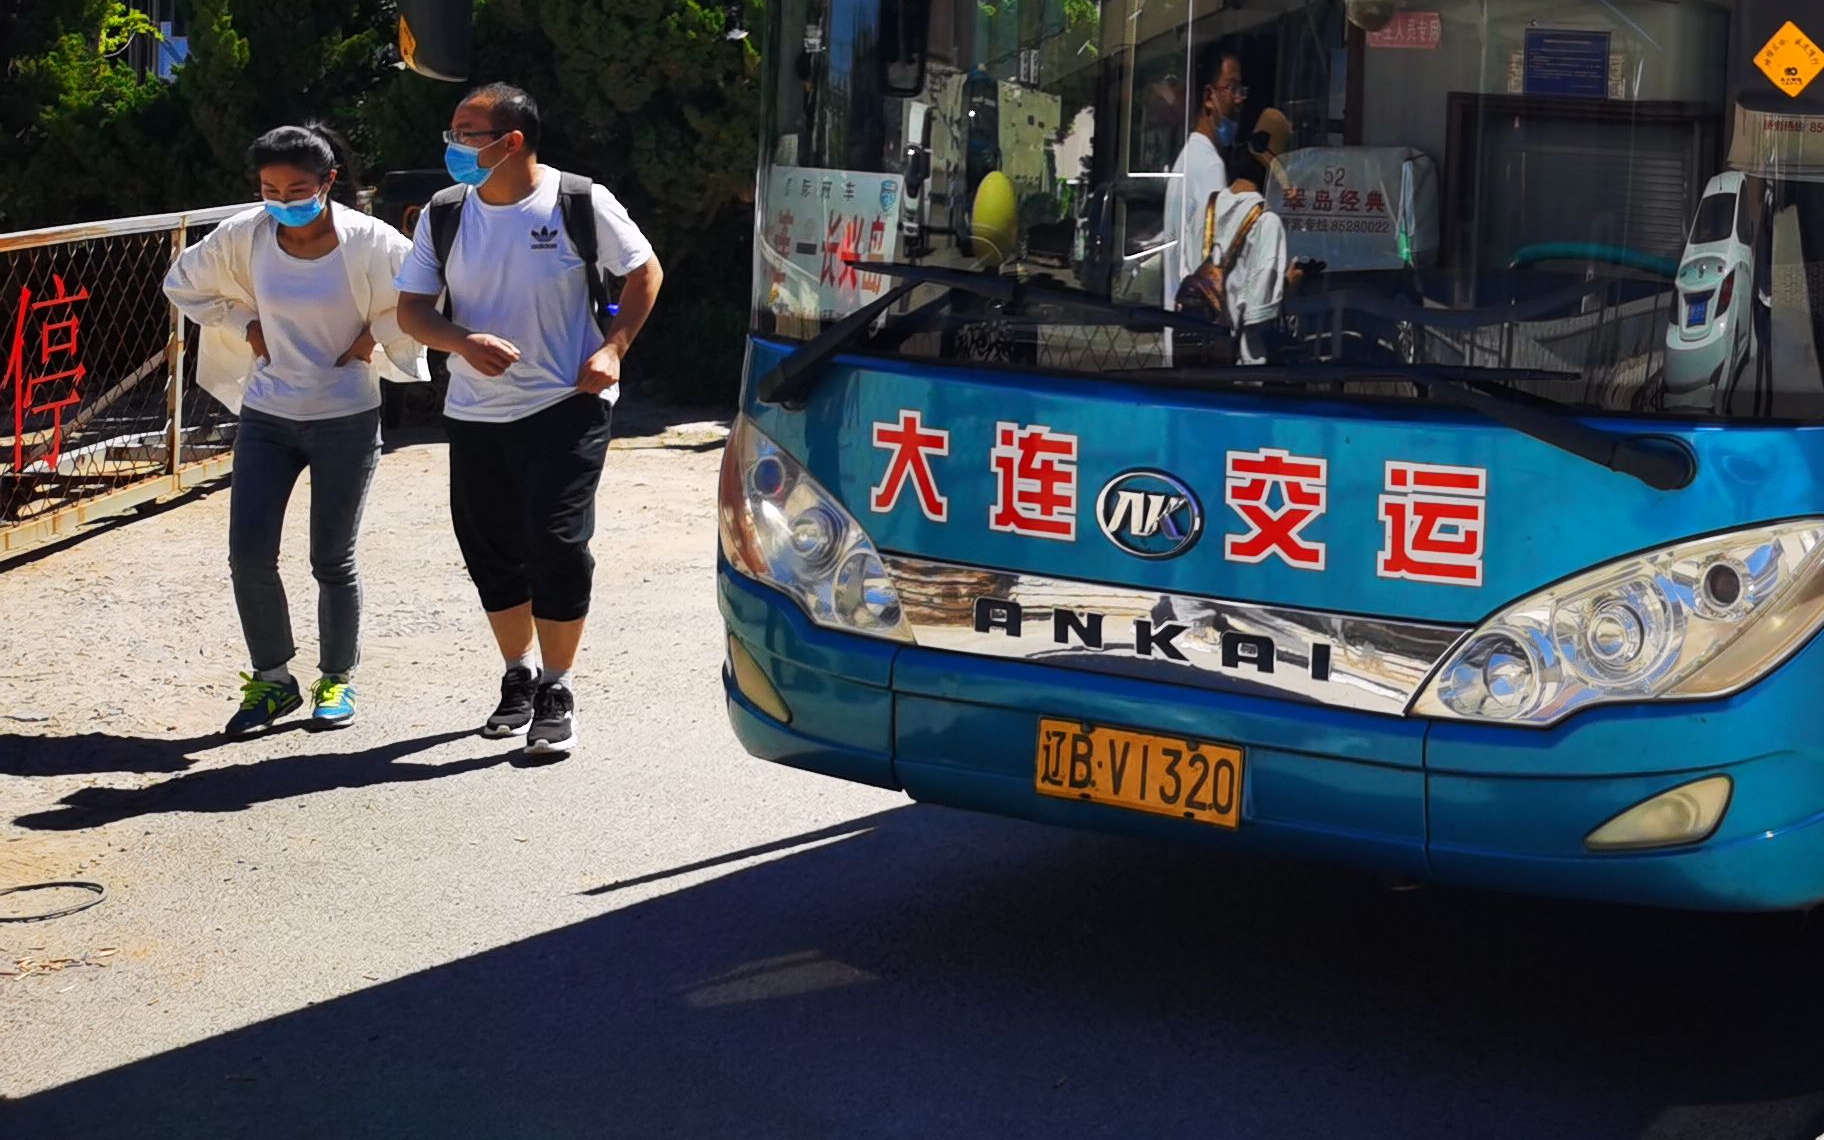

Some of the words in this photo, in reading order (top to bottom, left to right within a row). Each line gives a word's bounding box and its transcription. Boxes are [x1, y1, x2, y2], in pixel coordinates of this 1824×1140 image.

[1323, 165, 1346, 187] 52
[1, 274, 89, 475] 停
[870, 409, 1078, 543] 大连
[1224, 447, 1487, 587] 交运
[973, 597, 1331, 681] ANKAI
[1041, 730, 1235, 815] 辽B·V1320
